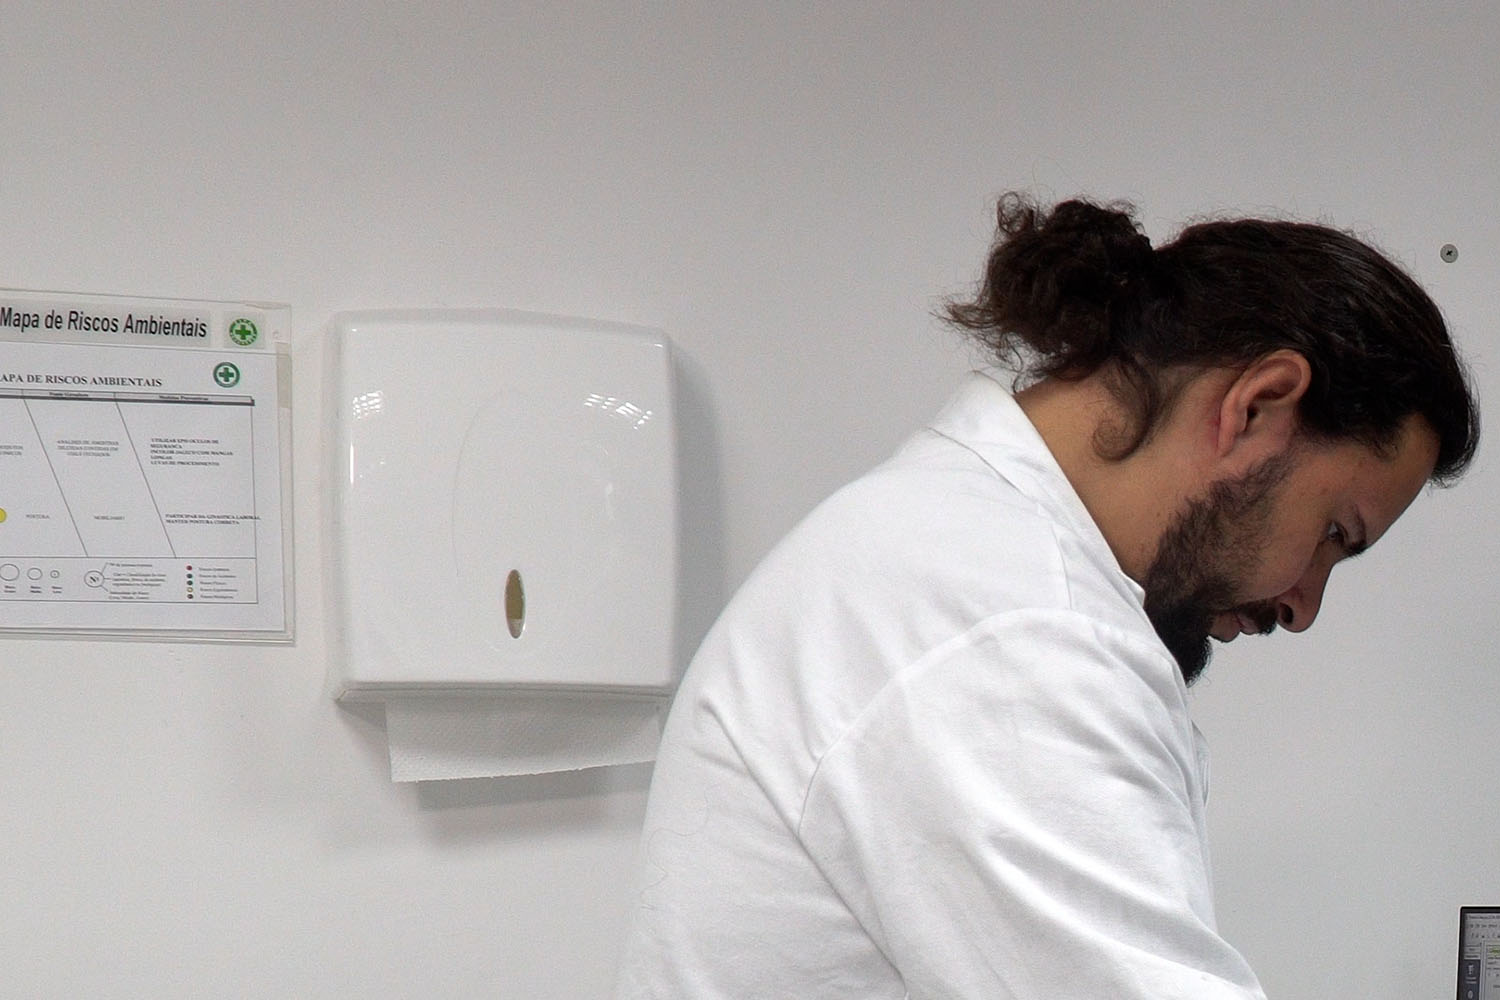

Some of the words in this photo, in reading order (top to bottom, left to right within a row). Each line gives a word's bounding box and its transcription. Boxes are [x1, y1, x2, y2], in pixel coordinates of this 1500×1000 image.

[0, 307, 40, 332] Mapa
[45, 310, 63, 330] de
[67, 311, 119, 332] Riscos
[123, 314, 207, 337] Ambientais
[0, 374, 23, 384] APA
[26, 374, 43, 384] DE
[45, 375, 88, 385] RISCOS
[89, 377, 163, 388] AMBIENTAIS
